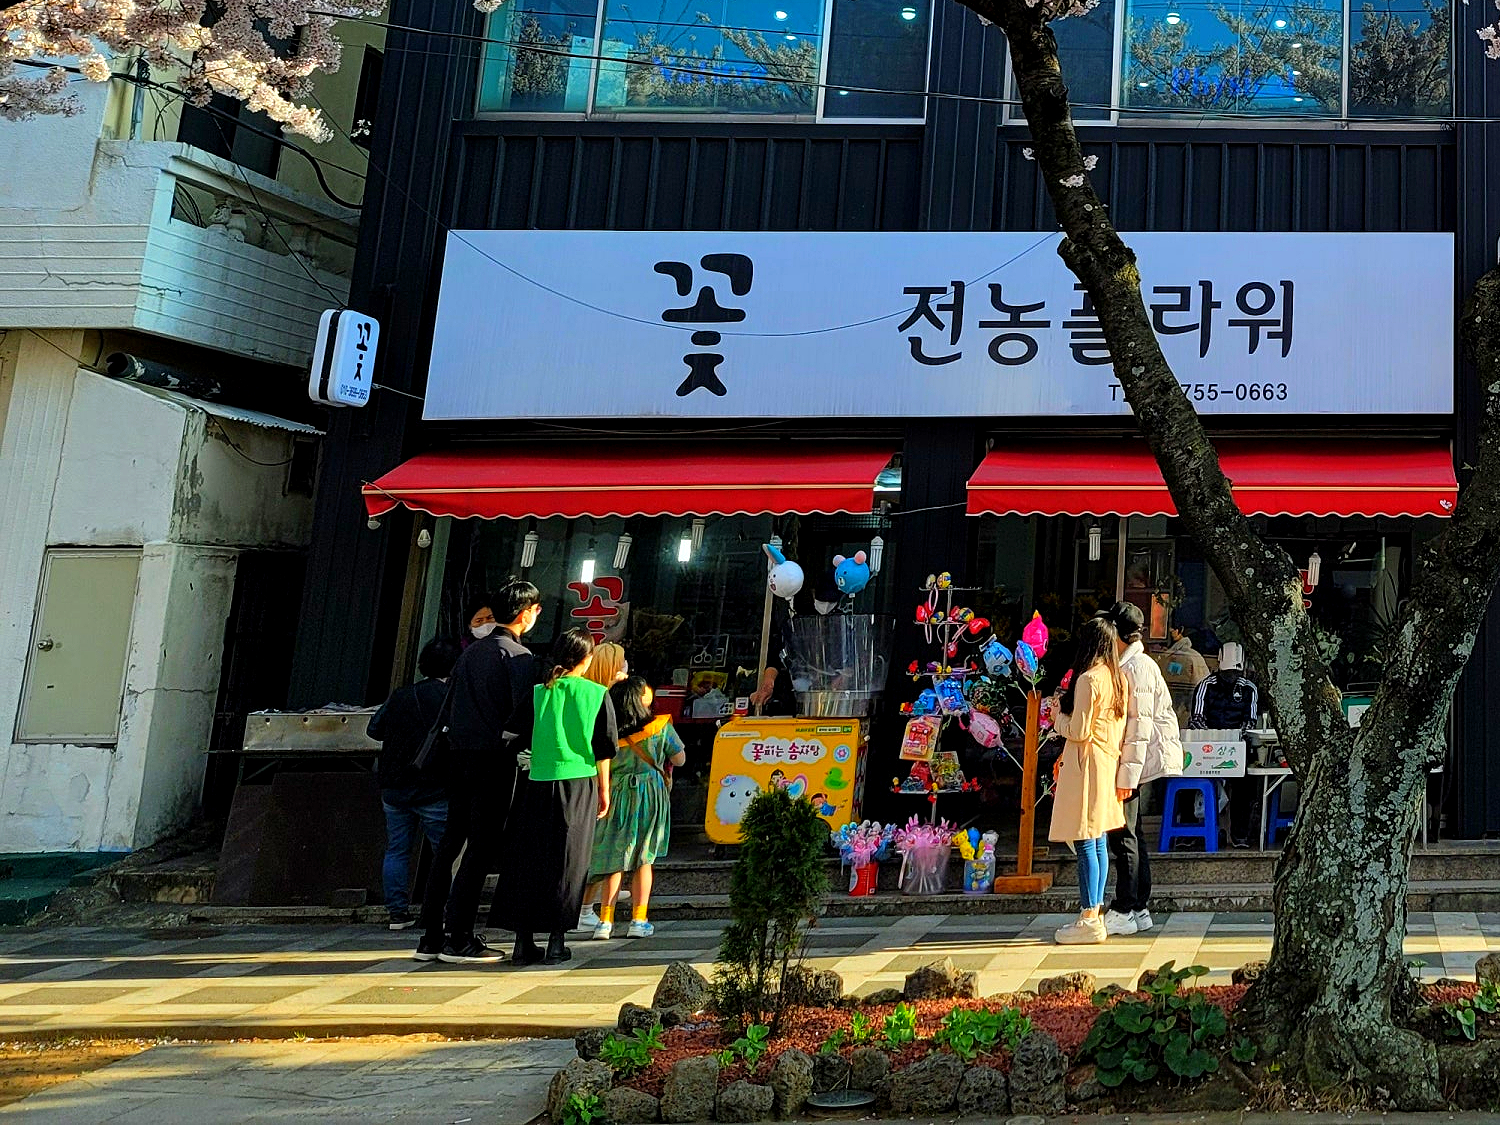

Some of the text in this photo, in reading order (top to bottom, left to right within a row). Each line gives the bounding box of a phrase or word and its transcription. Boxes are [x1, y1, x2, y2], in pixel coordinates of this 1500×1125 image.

[354, 322, 371, 382] 꽃
[653, 253, 753, 397] 꽃
[898, 280, 1294, 365] 전농플라워
